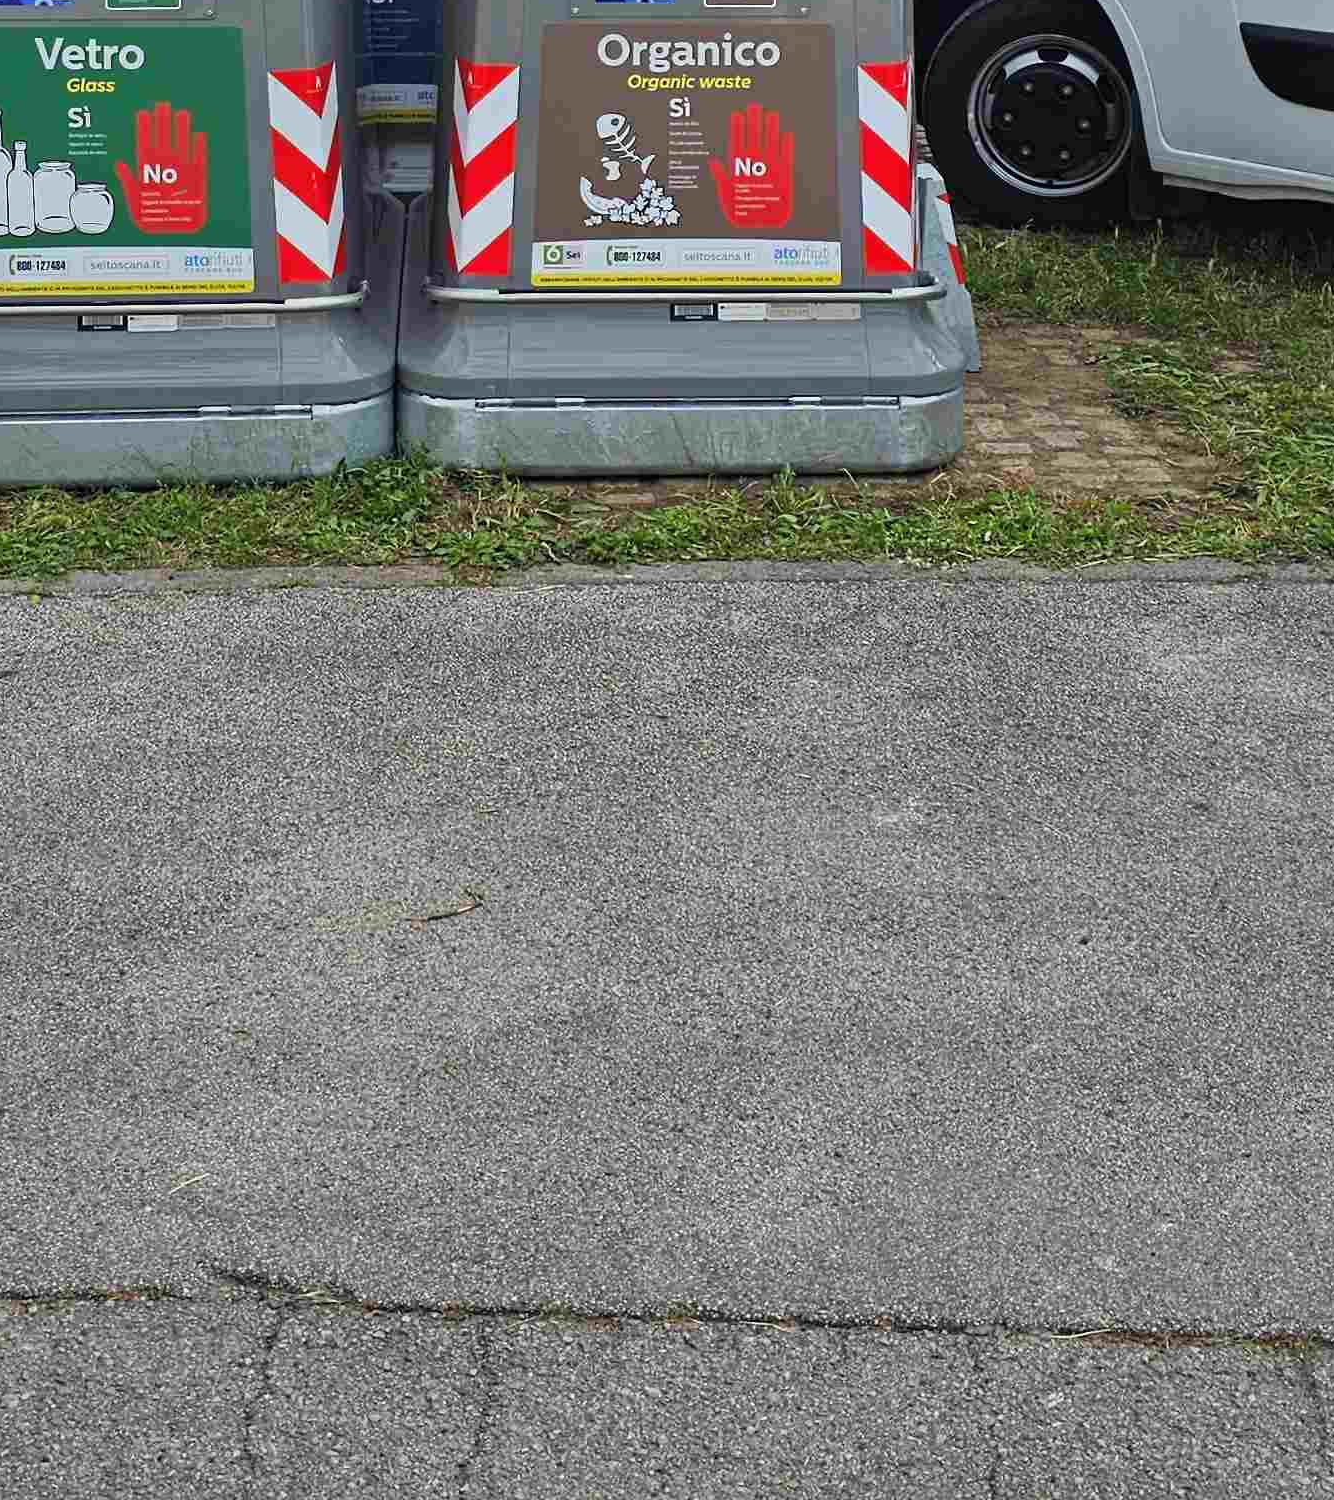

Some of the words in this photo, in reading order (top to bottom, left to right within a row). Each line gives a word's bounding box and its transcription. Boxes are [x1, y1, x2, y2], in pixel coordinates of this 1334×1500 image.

[34, 37, 145, 70] Vetro
[597, 32, 781, 73] Organico
[66, 77, 116, 93] Glass
[627, 74, 696, 91] Organic
[699, 76, 752, 88] waste
[67, 106, 91, 128] Sì
[669, 97, 691, 117] Sì
[143, 163, 178, 184] No
[734, 157, 767, 176] No
